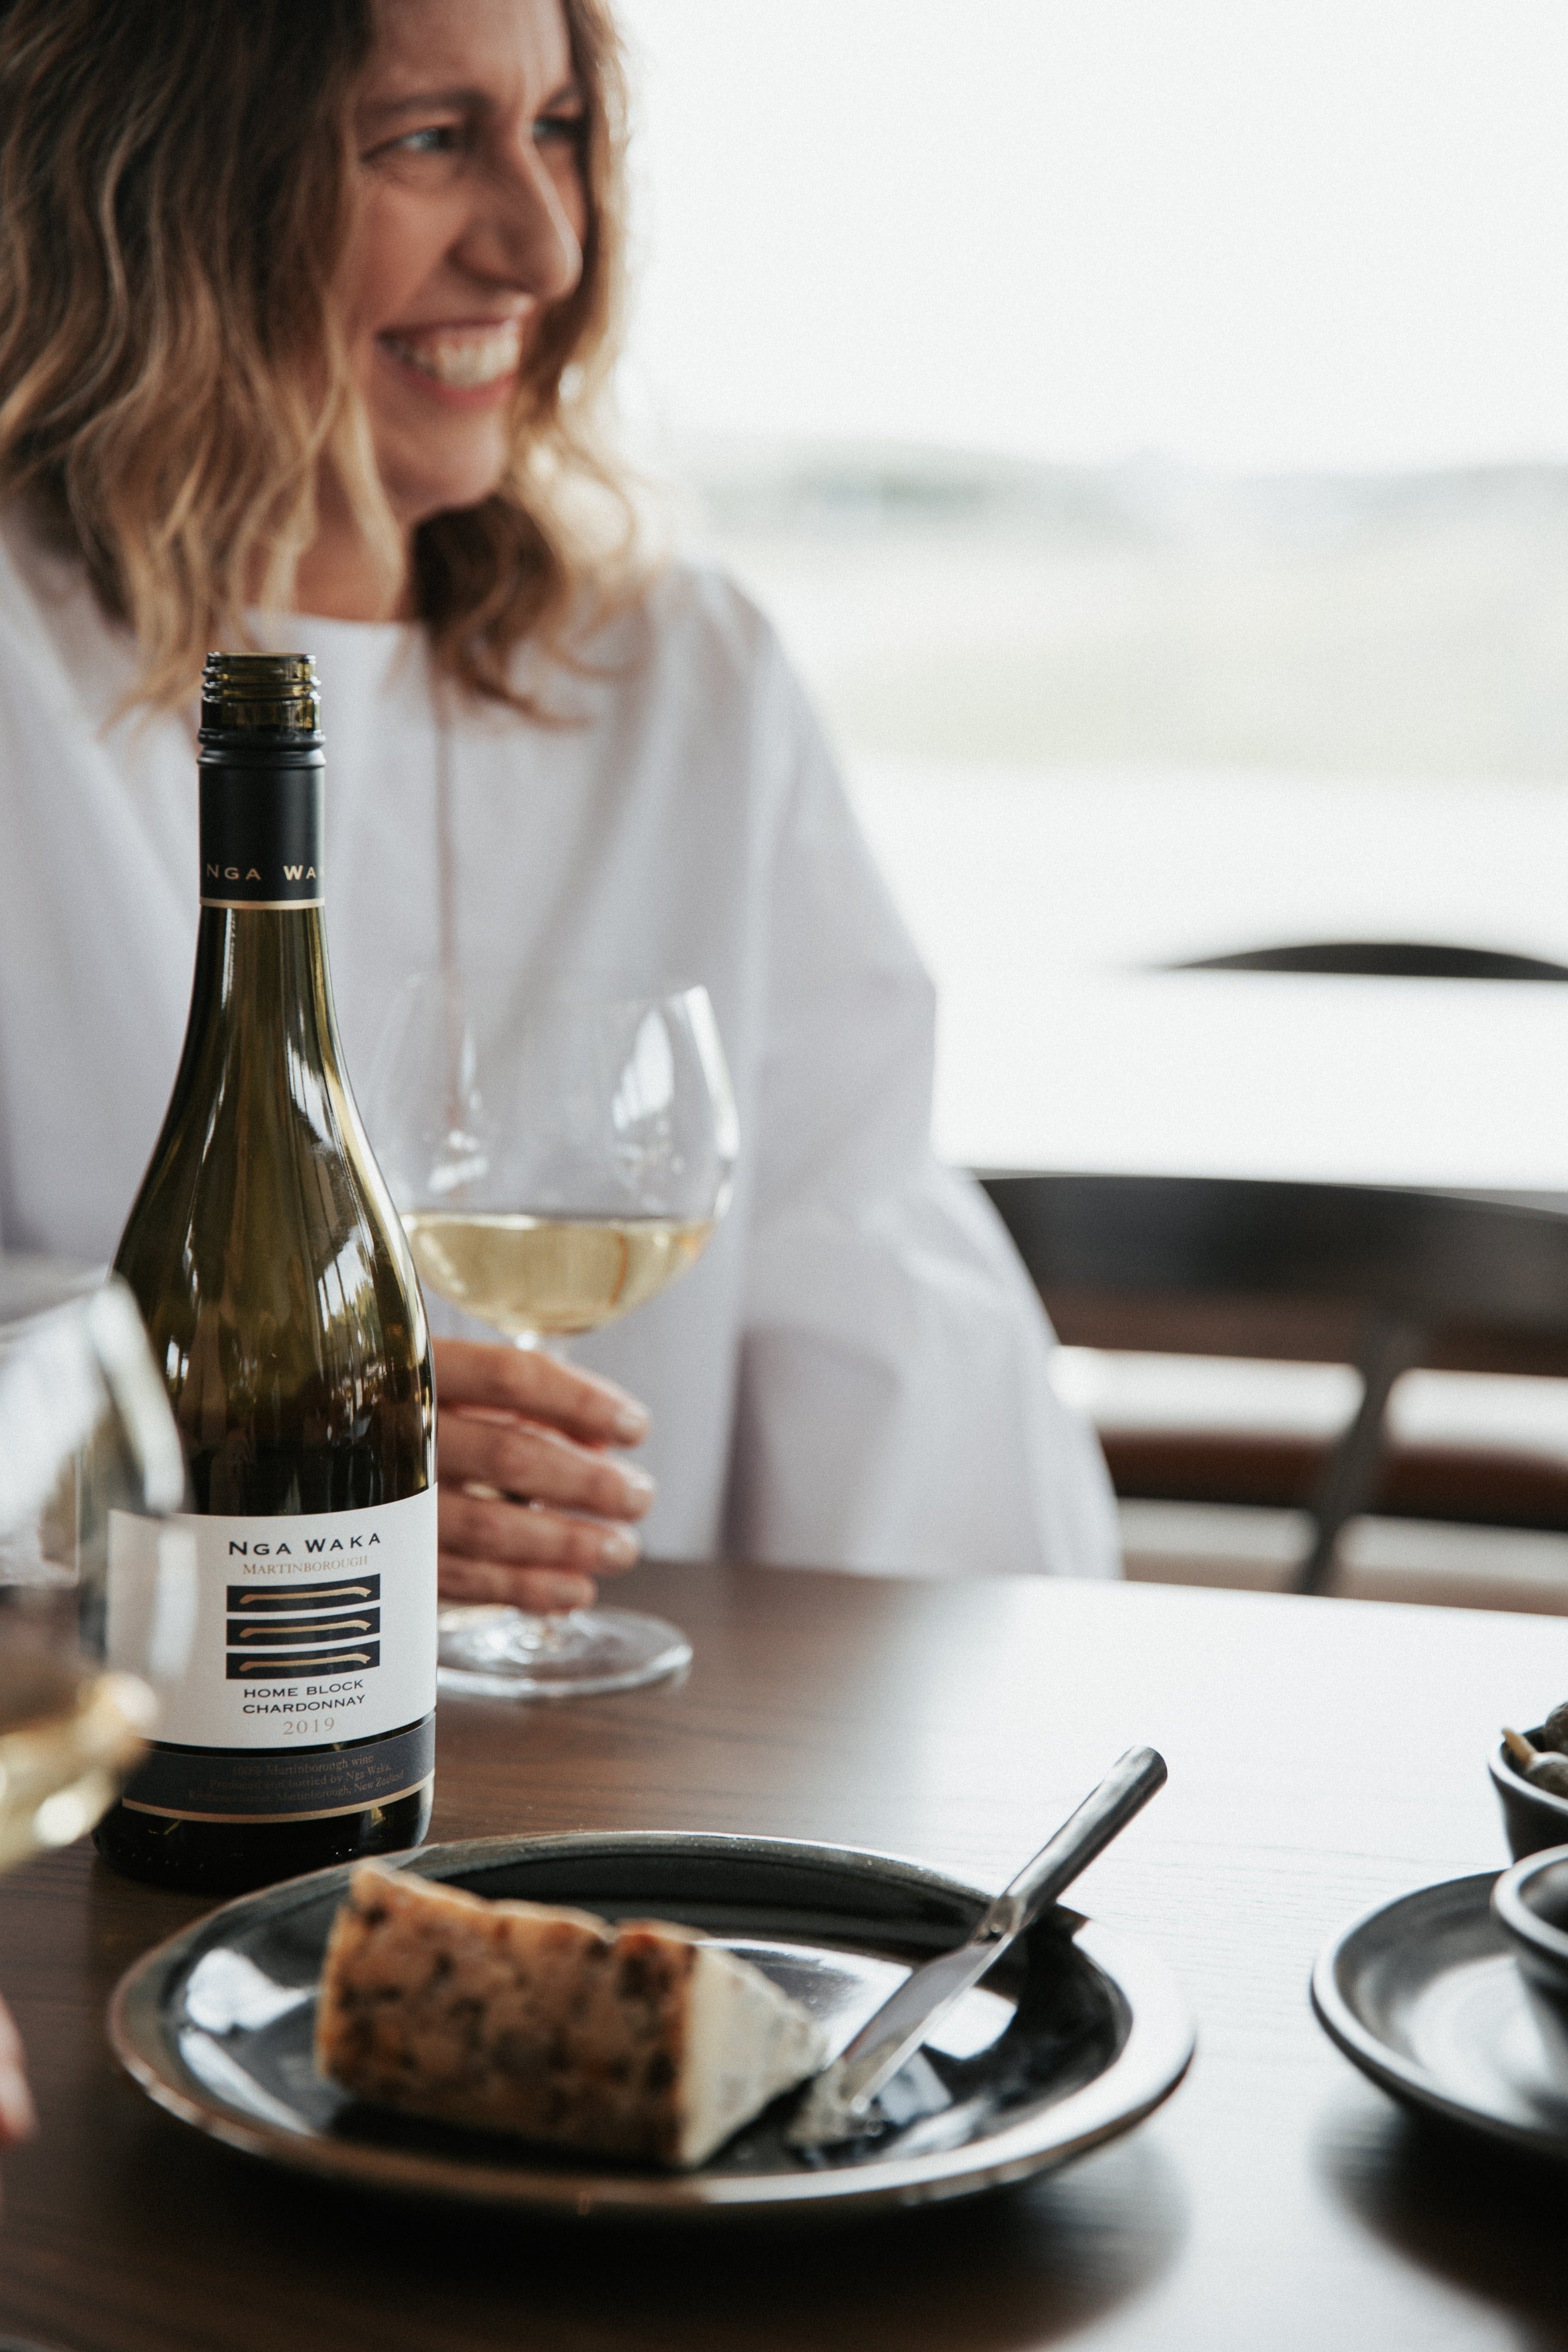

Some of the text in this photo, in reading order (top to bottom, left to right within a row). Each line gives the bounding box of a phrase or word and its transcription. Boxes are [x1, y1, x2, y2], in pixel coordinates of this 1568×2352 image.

[206, 863, 262, 881] NGA
[229, 1532, 381, 1555] NGA WAKA
[242, 1555, 367, 1575] MARTINBOROUGH
[243, 1679, 363, 1698] HOME BLOCK
[243, 1695, 365, 1714] CHARDONNAY
[282, 1717, 335, 1735] 2019
[351, 1753, 374, 1765] wine
[330, 1774, 343, 1785] by
[346, 1771, 365, 1782] Nga
[354, 1781, 375, 1792] New
[376, 1769, 404, 1787] Zealand
